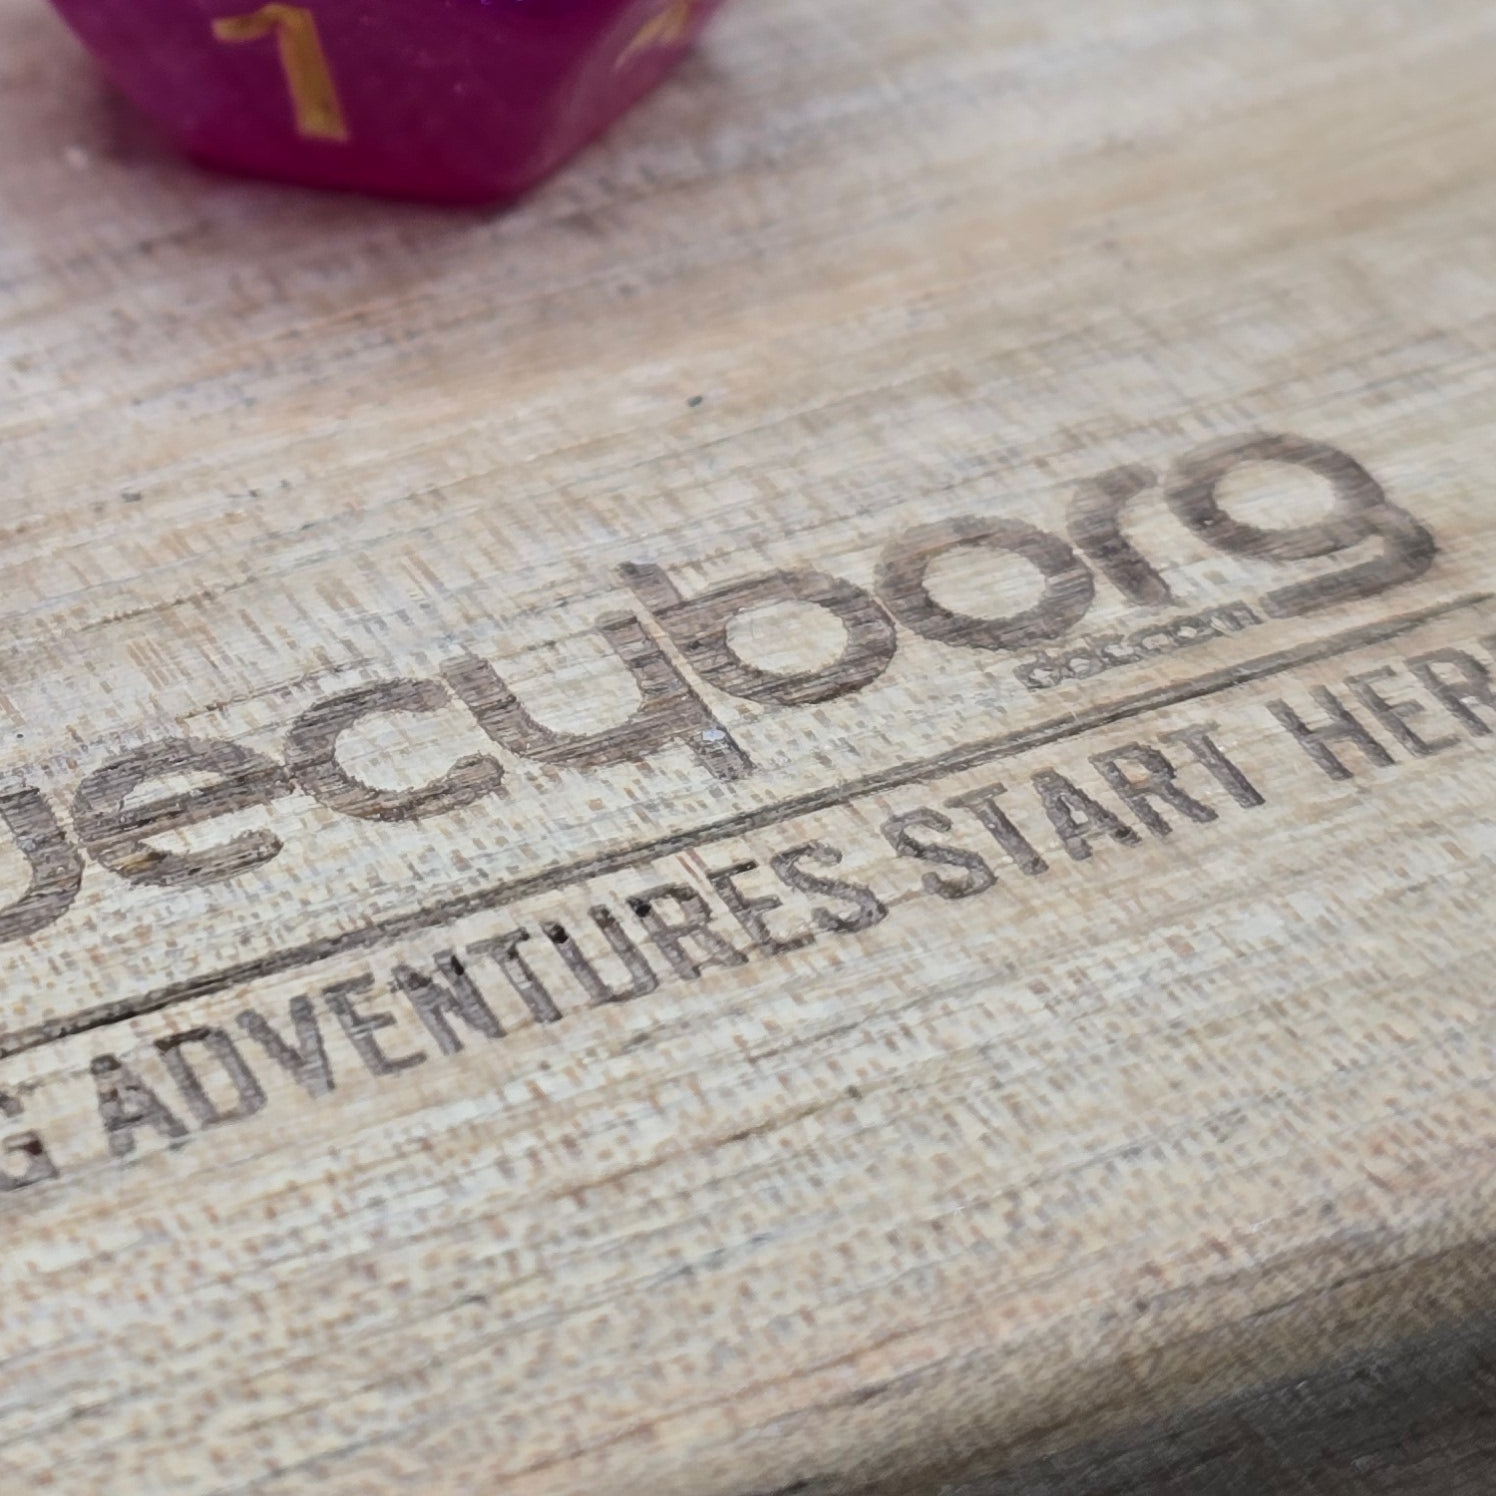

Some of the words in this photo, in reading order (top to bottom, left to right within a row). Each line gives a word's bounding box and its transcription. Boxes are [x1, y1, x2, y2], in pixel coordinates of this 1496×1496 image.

[91, 840, 889, 1153] ADVENTURES
[881, 721, 1267, 902] START
[1265, 632, 1496, 782] HER
